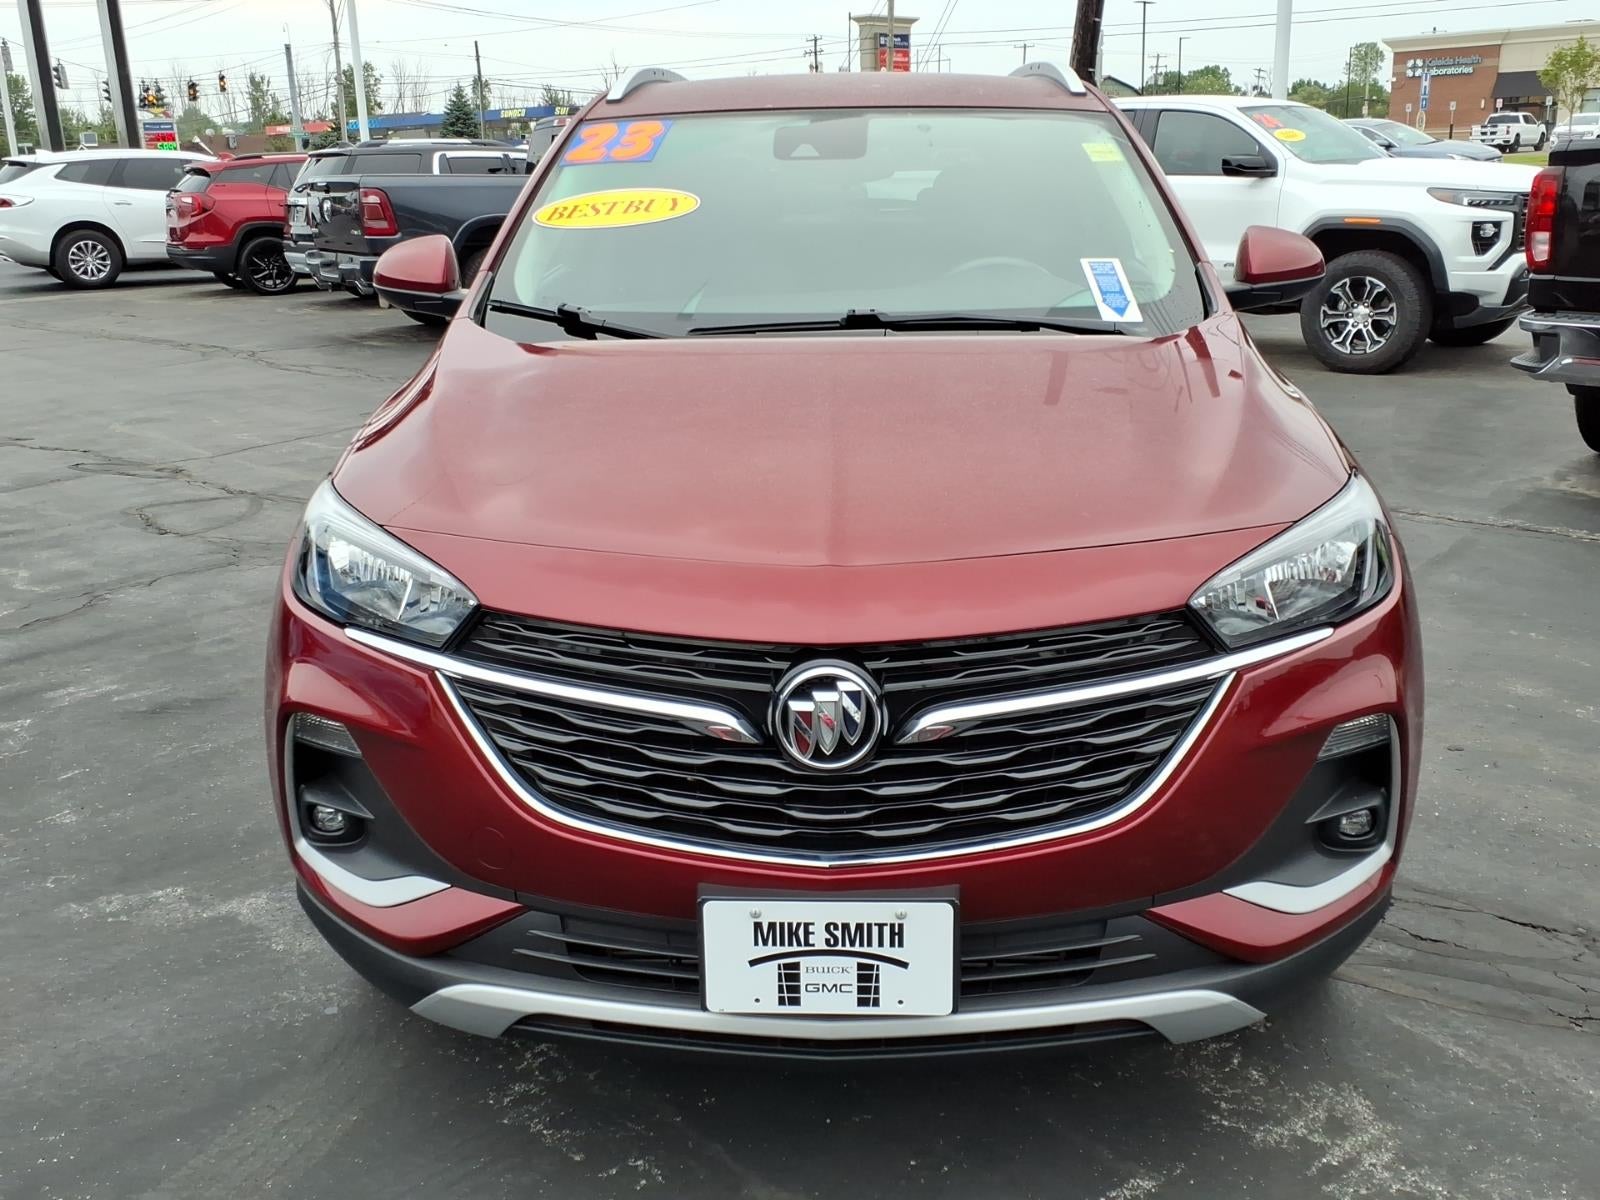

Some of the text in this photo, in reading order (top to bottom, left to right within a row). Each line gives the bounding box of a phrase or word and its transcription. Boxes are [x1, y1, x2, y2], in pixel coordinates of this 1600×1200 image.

[1456, 54, 1481, 64] Health
[1425, 65, 1473, 76] Laboratories
[501, 108, 525, 118] SUNOCO
[563, 120, 665, 163] 23
[753, 921, 904, 948] MIKE SMITH
[805, 966, 852, 974] BUICK
[804, 983, 853, 993] GMC
